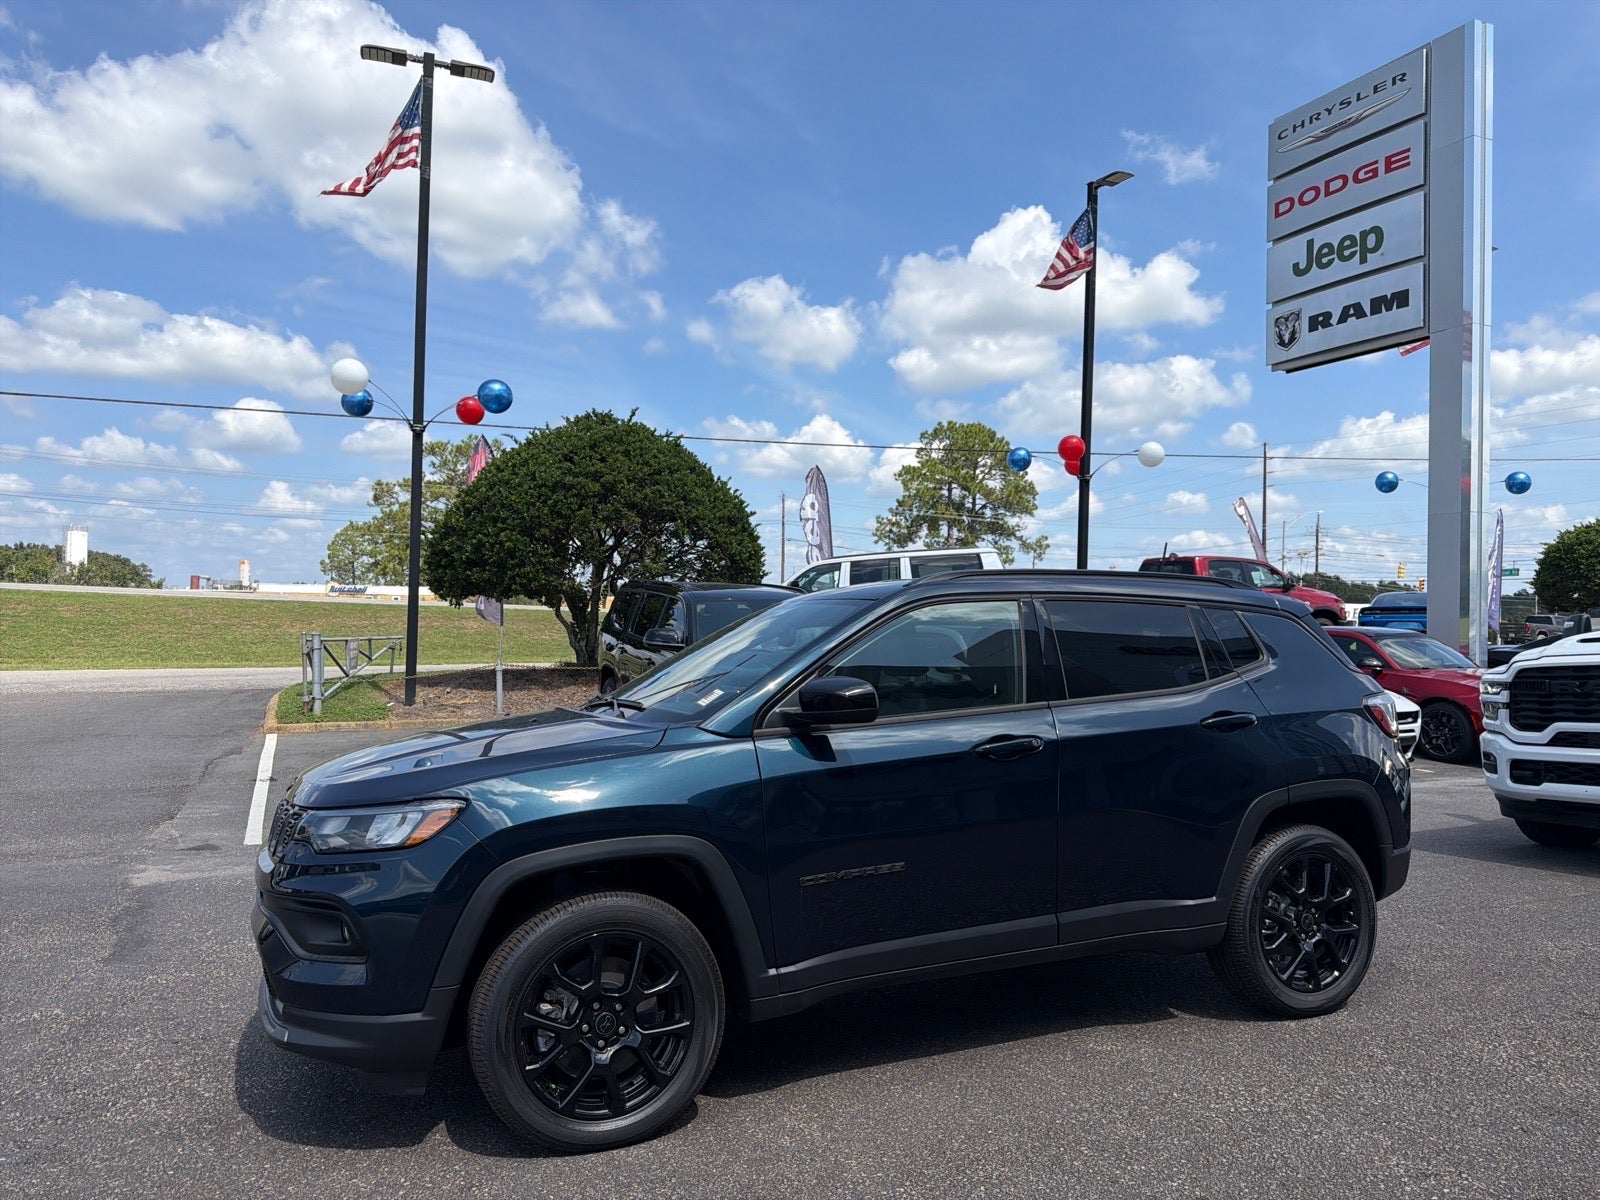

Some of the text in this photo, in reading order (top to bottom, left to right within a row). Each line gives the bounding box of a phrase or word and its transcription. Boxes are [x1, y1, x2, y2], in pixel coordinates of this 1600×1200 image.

[1277, 71, 1407, 141] CHRYSLER
[1274, 147, 1411, 219] DODGE
[1292, 225, 1384, 277] Jeep
[1308, 288, 1410, 333] RAM
